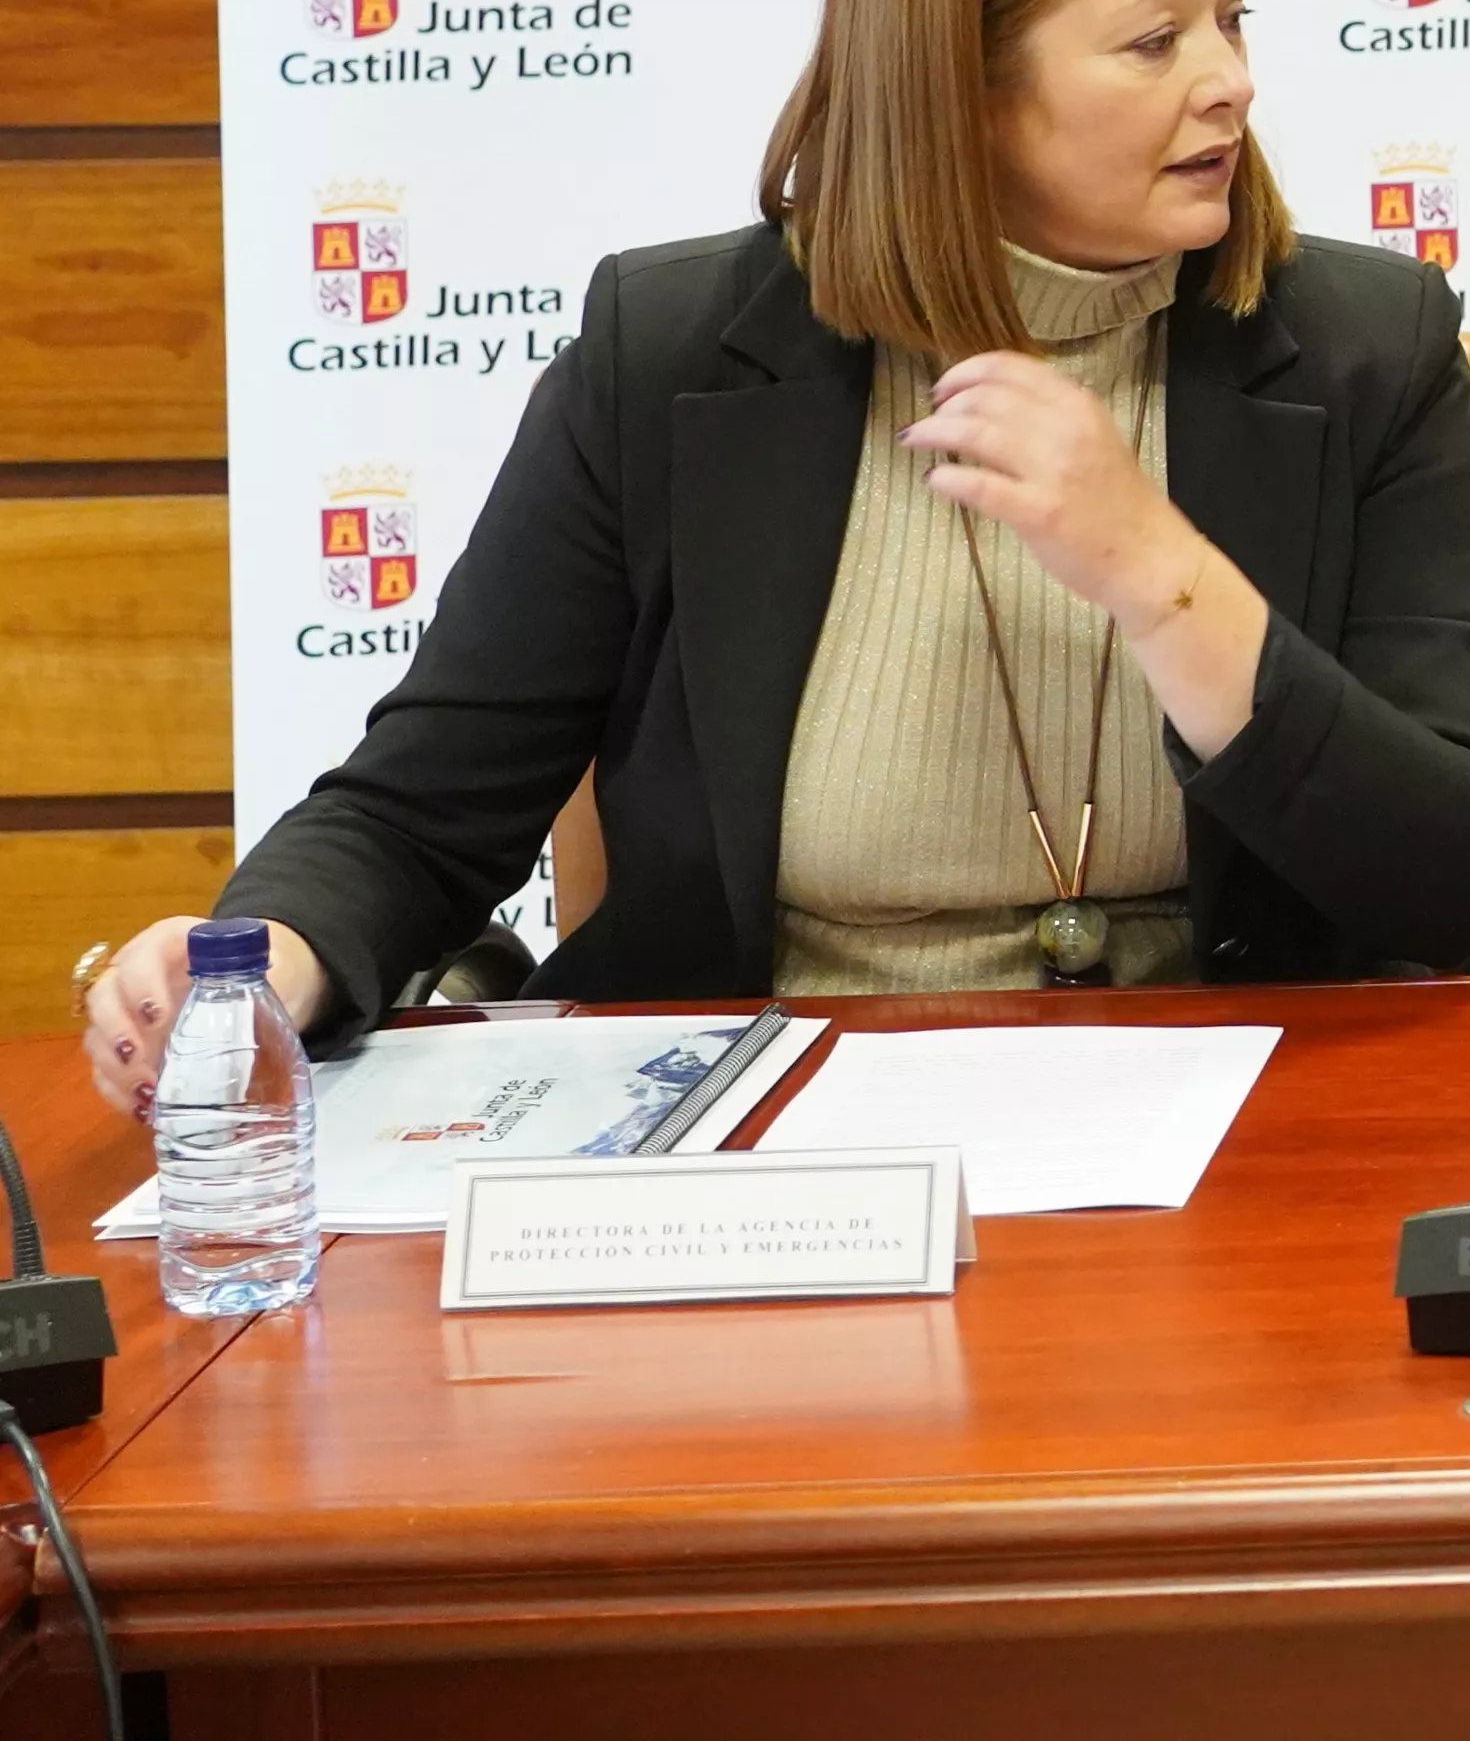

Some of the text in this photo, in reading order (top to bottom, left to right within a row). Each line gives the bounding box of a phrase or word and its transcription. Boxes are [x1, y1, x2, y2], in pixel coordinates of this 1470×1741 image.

[419, 2, 551, 32] Junta
[281, 48, 630, 89] Castilla y León
[428, 287, 561, 317] Junta
[290, 336, 458, 370] Castilla
[481, 340, 504, 373] y
[471, 1079, 527, 1119] Junta de
[479, 1110, 529, 1142] Castilla
[517, 1078, 560, 1100] León
[520, 1217, 874, 1240] DIRECTORA DE LA AGENCIA DE
[489, 1238, 904, 1263] PROTECCIÓN CIVIL Y EMERGENCIAS
